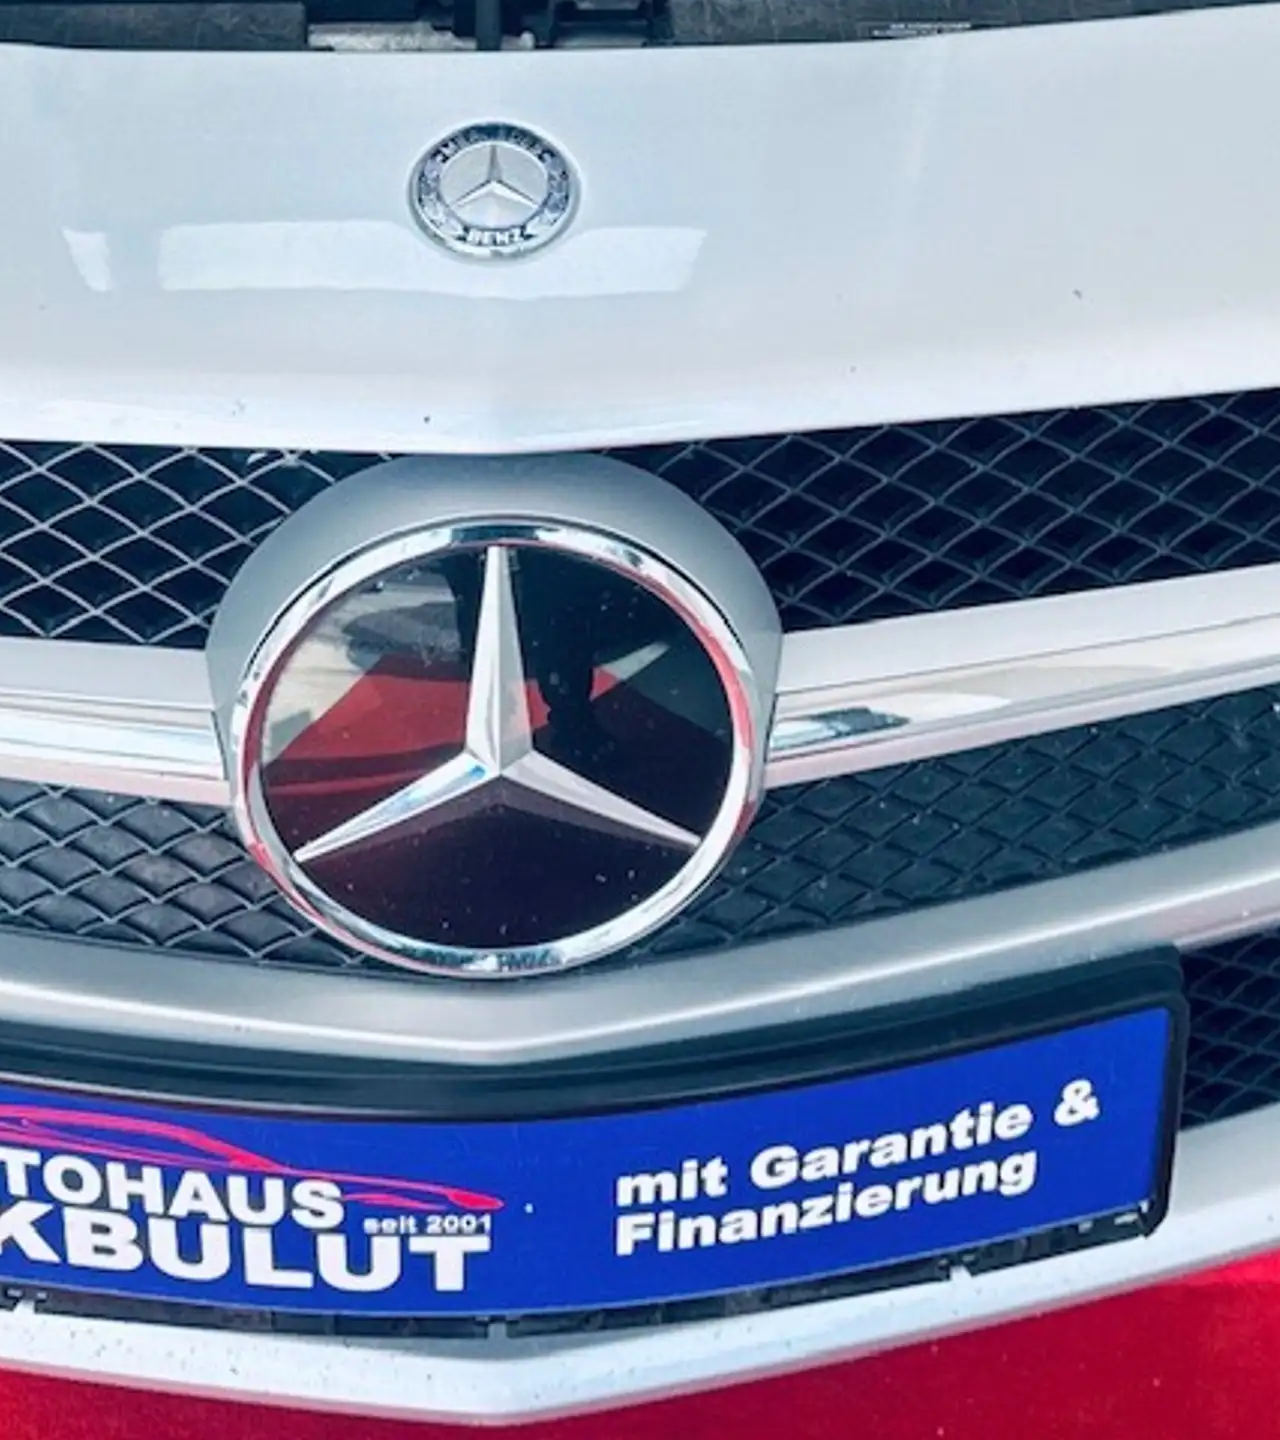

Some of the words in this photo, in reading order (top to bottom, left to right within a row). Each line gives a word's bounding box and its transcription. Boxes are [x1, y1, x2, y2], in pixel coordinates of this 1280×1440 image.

[615, 1156, 729, 1208] mit
[749, 1100, 1034, 1190] Garantie
[1053, 1078, 1100, 1127] &
[363, 1216, 417, 1236] seit
[426, 1214, 492, 1235] 2001
[615, 1149, 1038, 1257] Finanzierung
